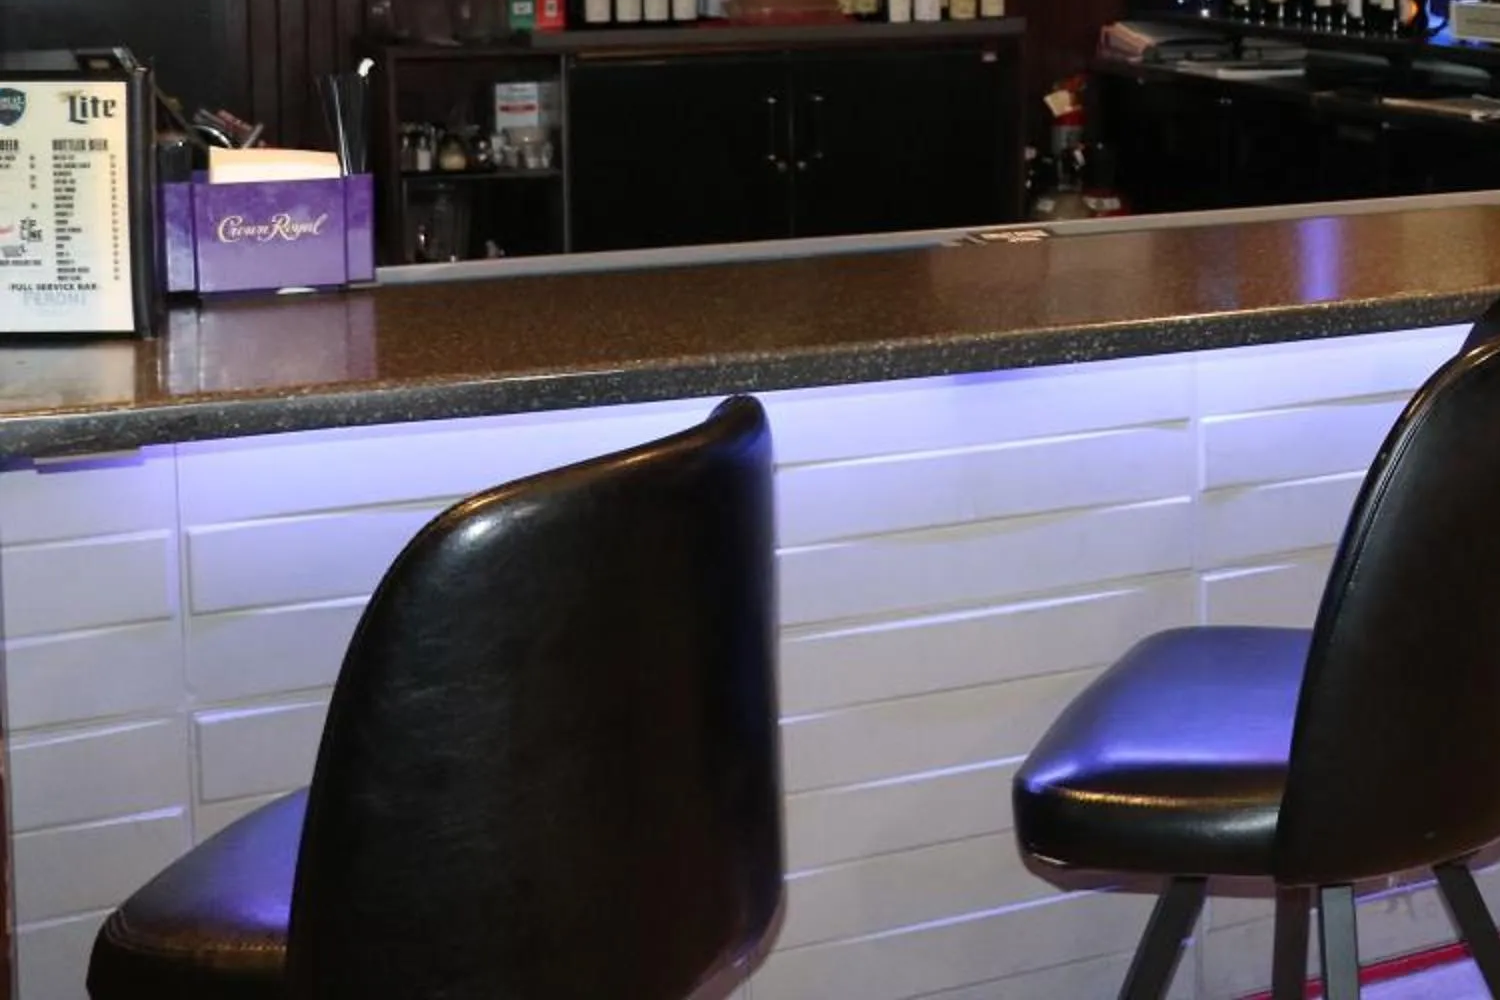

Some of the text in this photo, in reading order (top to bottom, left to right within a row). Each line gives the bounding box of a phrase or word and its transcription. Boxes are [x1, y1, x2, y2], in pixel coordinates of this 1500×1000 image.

[65, 91, 117, 124] Lite
[217, 213, 329, 243] Crown Royal
